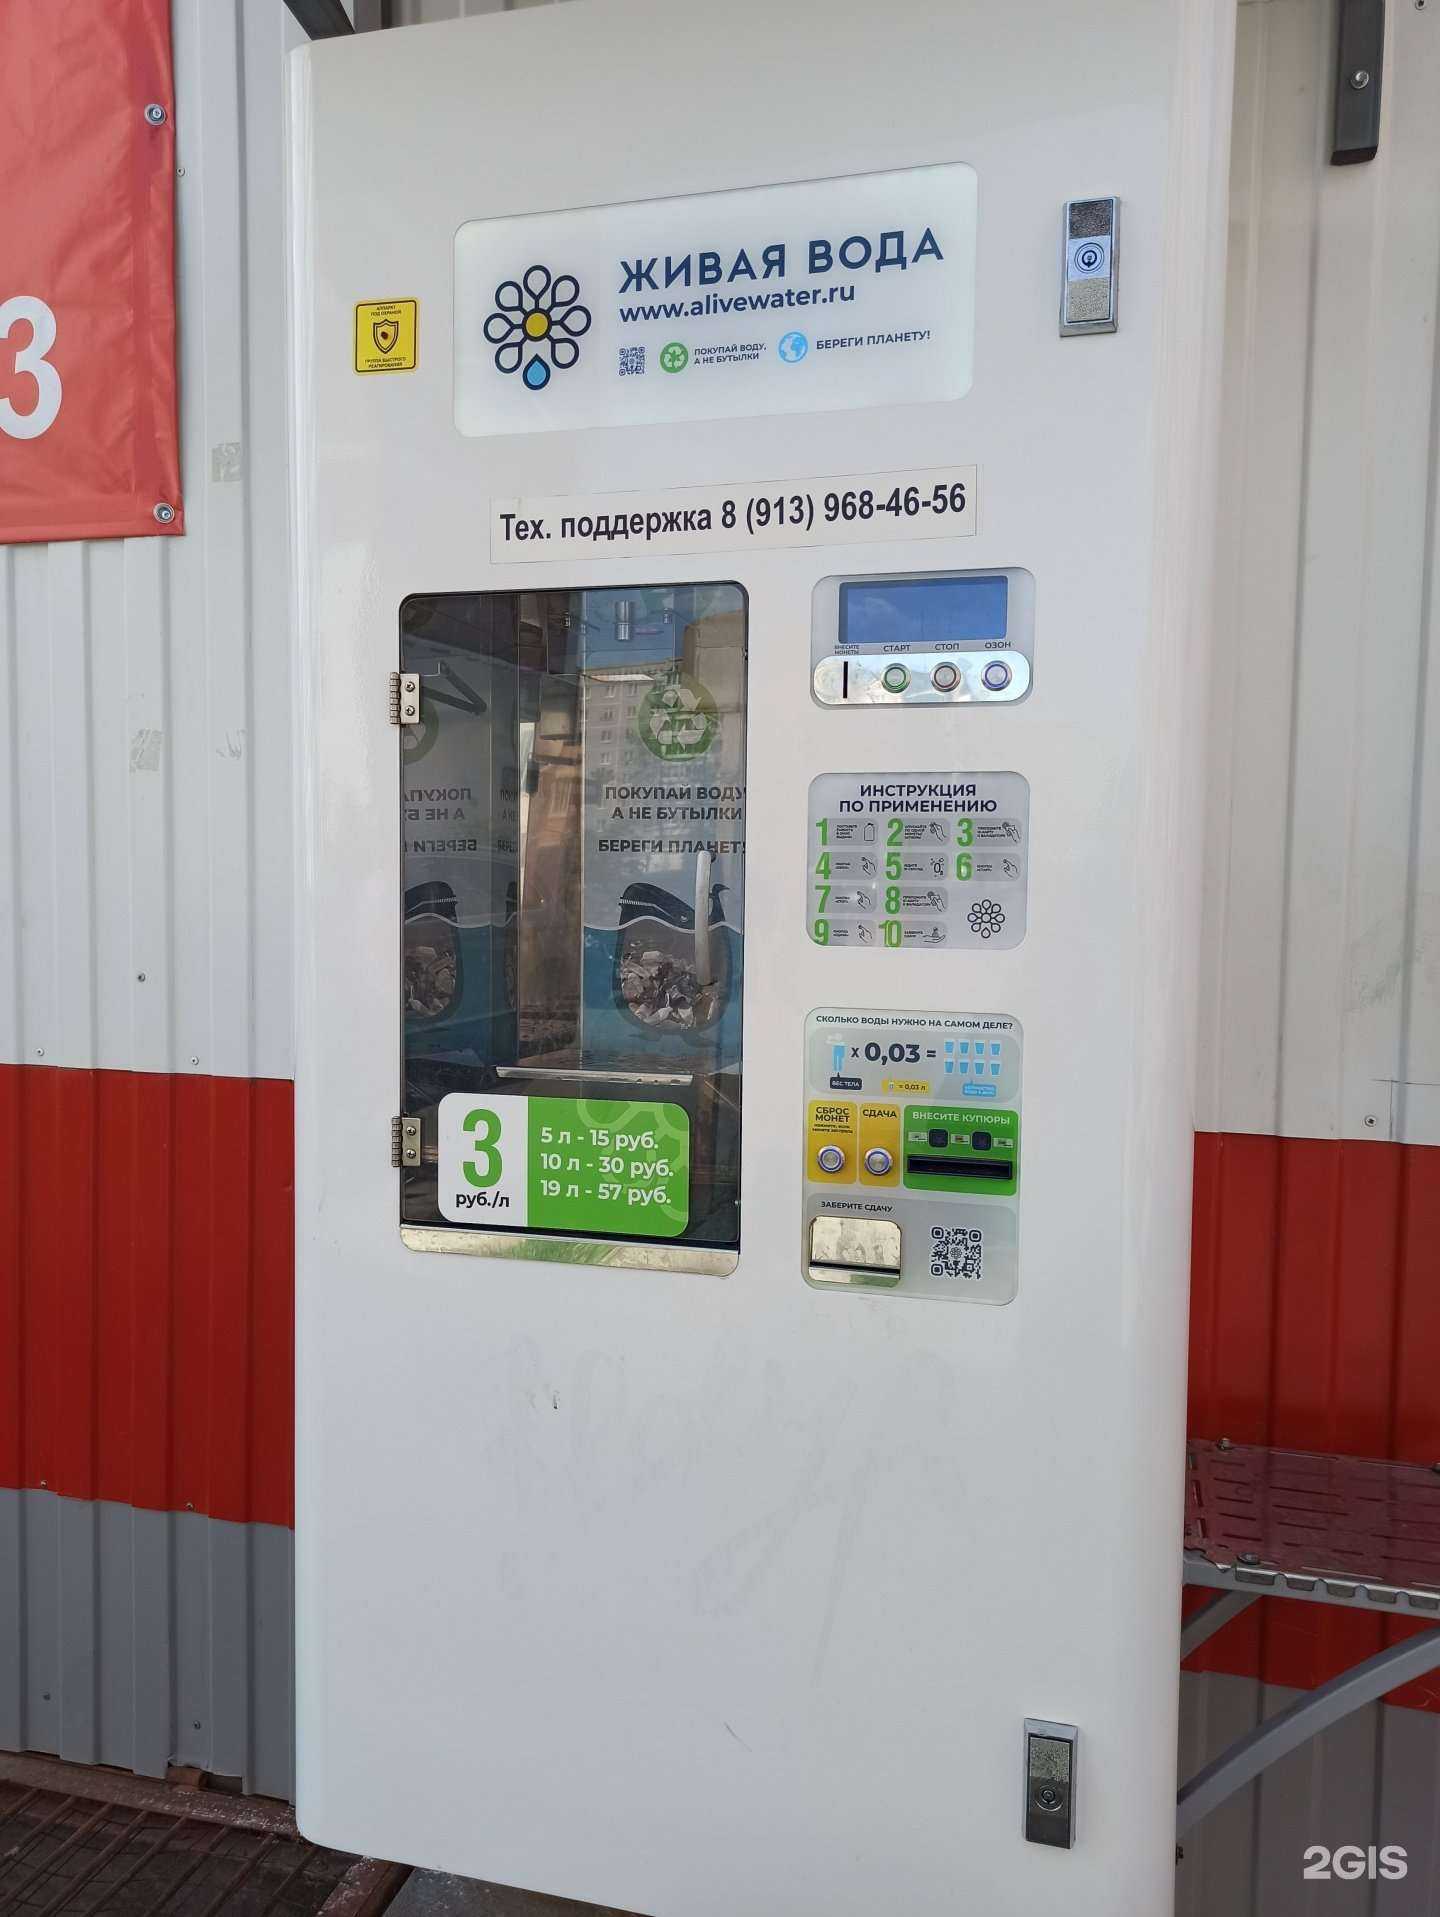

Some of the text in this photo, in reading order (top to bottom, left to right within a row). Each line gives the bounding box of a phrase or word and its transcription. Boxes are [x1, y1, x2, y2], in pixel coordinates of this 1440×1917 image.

[618, 227, 944, 294] ЖИВАЯ ВОДА
[618, 285, 855, 323] www.alivewater.ru
[694, 343, 738, 356] ПОКУПАЙ
[816, 329, 931, 350] БЕРЕГИ ПЛАНЕТУ!
[0, 295, 62, 440] 3
[694, 352, 760, 365] А НЕ БУТЫЛКИ
[499, 483, 966, 542] Тех. поддержка 8 (913) 968-46-56
[883, 641, 1012, 652] СТАРТ СТОП ОЗОН
[605, 784, 691, 800] ПОКУПАЙ
[860, 783, 976, 798] ИНСТРУКЦИЯ
[612, 807, 742, 820] А НЕ БУТЫЛКИ
[840, 800, 997, 812] ПО ПРИМЕНЕНИЮ
[816, 818, 828, 846] 1
[886, 818, 904, 847] 2
[956, 818, 974, 847] 3
[598, 840, 663, 852] БЕРЕГИ
[816, 852, 832, 880] 4
[886, 852, 902, 880] 5
[956, 852, 972, 881] 6
[815, 886, 832, 913] 7
[885, 886, 901, 914] 8
[814, 919, 829, 945] 9
[878, 920, 902, 948] 10
[816, 1015, 1014, 1030] СКОЛЬКО ВОДЫ НУЖНО НА САМОМ ДЕЛЕ?
[864, 1042, 921, 1066] 0,03
[816, 1106, 897, 1118] СБРОС СДАЧА
[816, 1114, 850, 1122] МОНЕТ
[912, 1112, 1010, 1125] ВНЕСИТЕ КУПЮРЫ
[462, 1108, 503, 1188] 3
[540, 1127, 553, 1144] 5
[557, 1131, 571, 1145] л
[589, 1129, 610, 1146] 15
[615, 1131, 659, 1152] руб.
[540, 1153, 562, 1171] 10
[566, 1157, 580, 1172] л
[598, 1156, 624, 1174] 30
[630, 1158, 674, 1180] руб.
[456, 1191, 510, 1208] руб./л
[540, 1180, 561, 1197] 19
[566, 1184, 580, 1198] л
[598, 1184, 622, 1201] 57
[628, 1186, 672, 1206] руб.
[821, 1201, 893, 1213] ЗАБЕРИТЕ СДАЧУ
